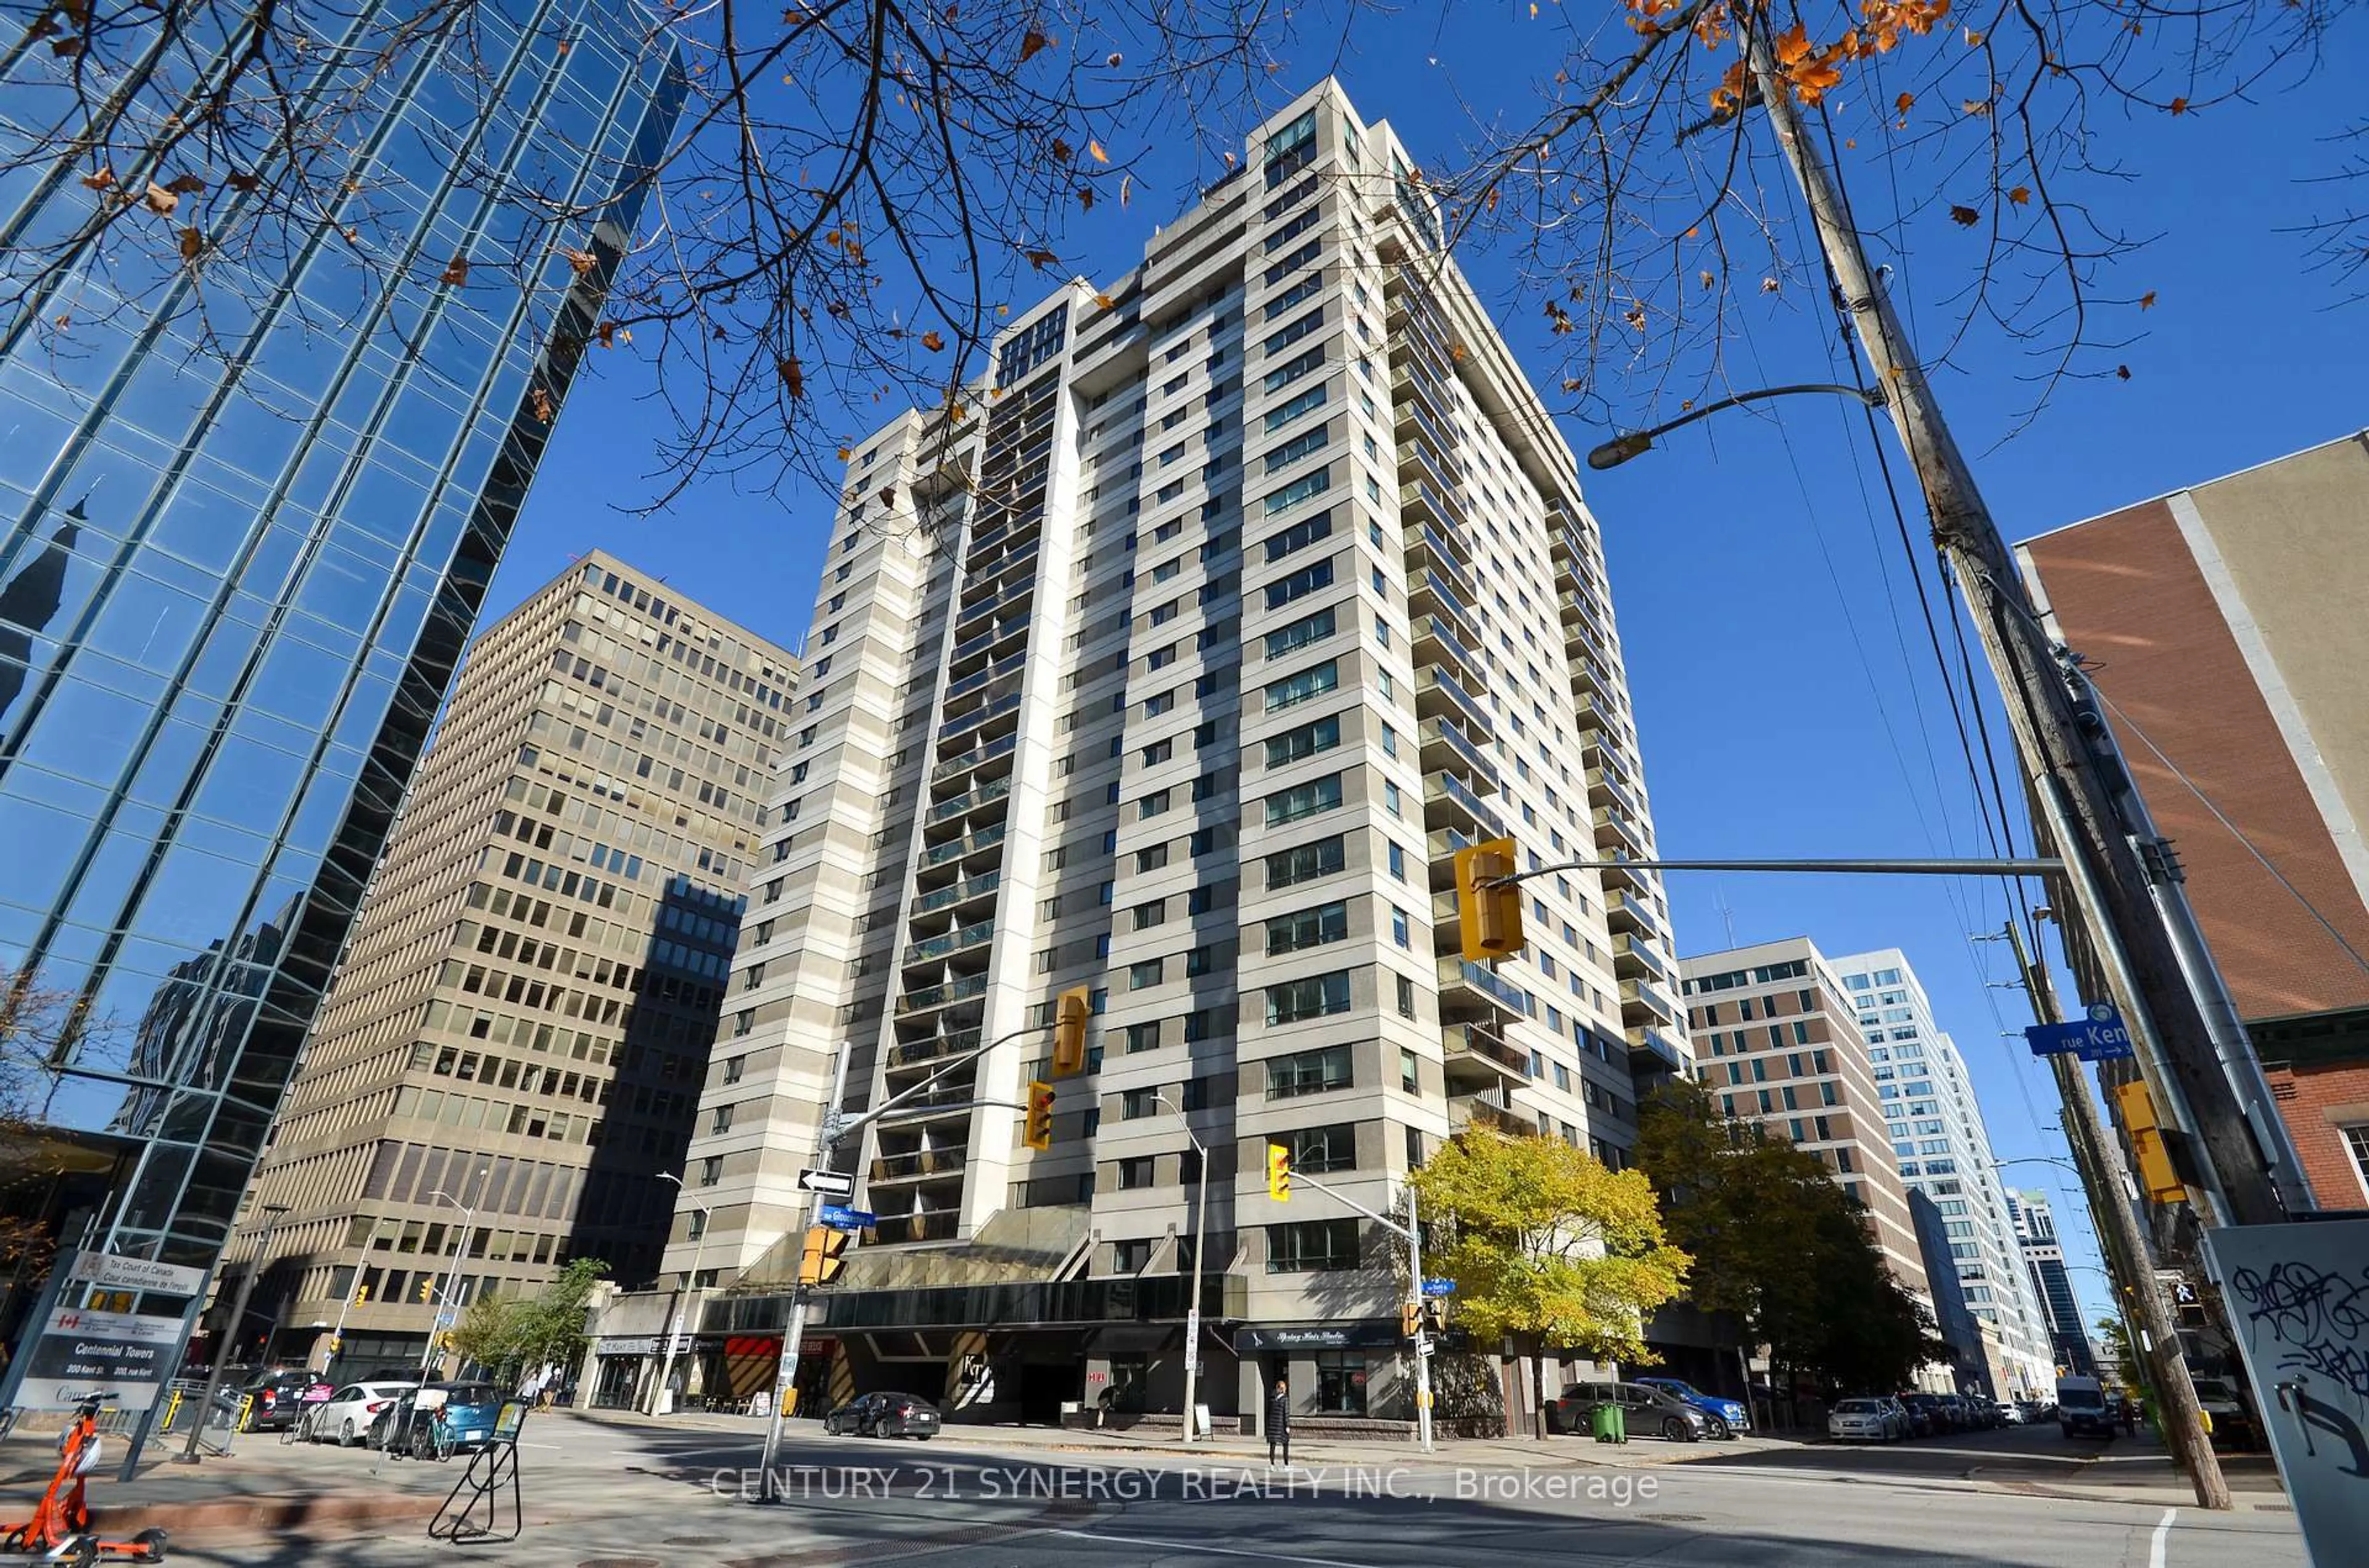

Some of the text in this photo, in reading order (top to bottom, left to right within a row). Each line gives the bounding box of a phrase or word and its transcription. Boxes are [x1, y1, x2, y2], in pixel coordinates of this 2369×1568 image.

[2061, 1026, 2128, 1049] rue Ken
[123, 1262, 142, 1273] Court
[142, 1265, 149, 1273] of
[150, 1266, 175, 1276] Canada
[104, 1273, 120, 1282] Cour
[75, 1343, 154, 1358] Centennial Towers
[81, 1364, 95, 1373] Kent
[139, 1368, 153, 1376] Kent
